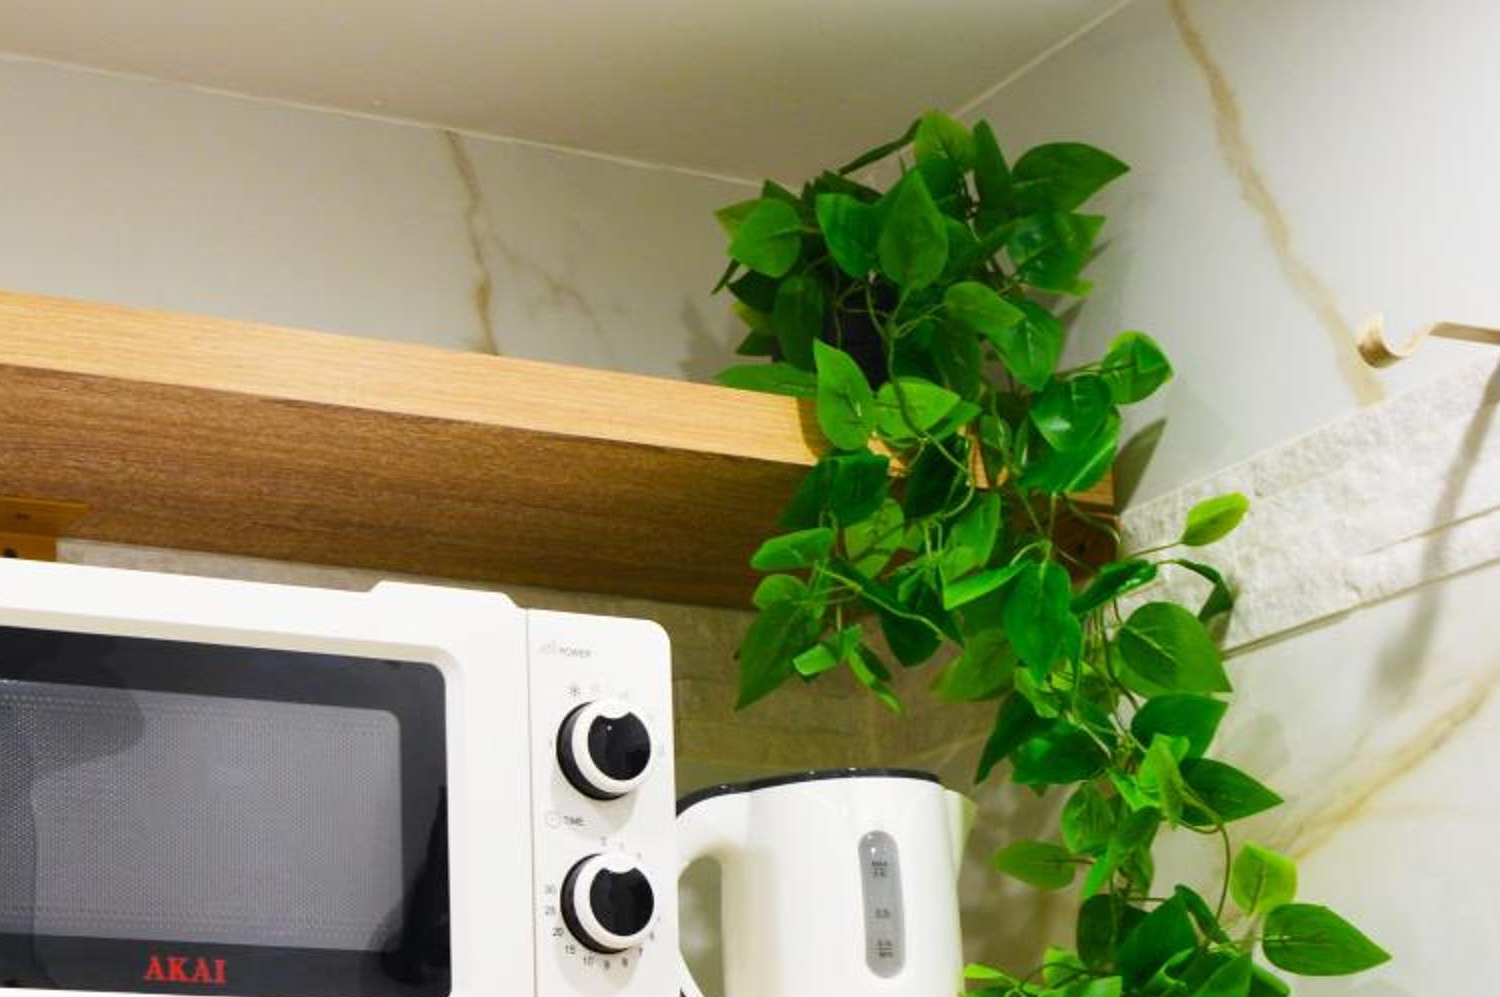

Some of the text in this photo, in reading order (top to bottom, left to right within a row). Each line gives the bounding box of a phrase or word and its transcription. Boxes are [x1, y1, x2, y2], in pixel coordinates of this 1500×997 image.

[559, 646, 591, 658] POWER
[563, 815, 585, 827] TIME
[143, 956, 227, 985] AKAI
